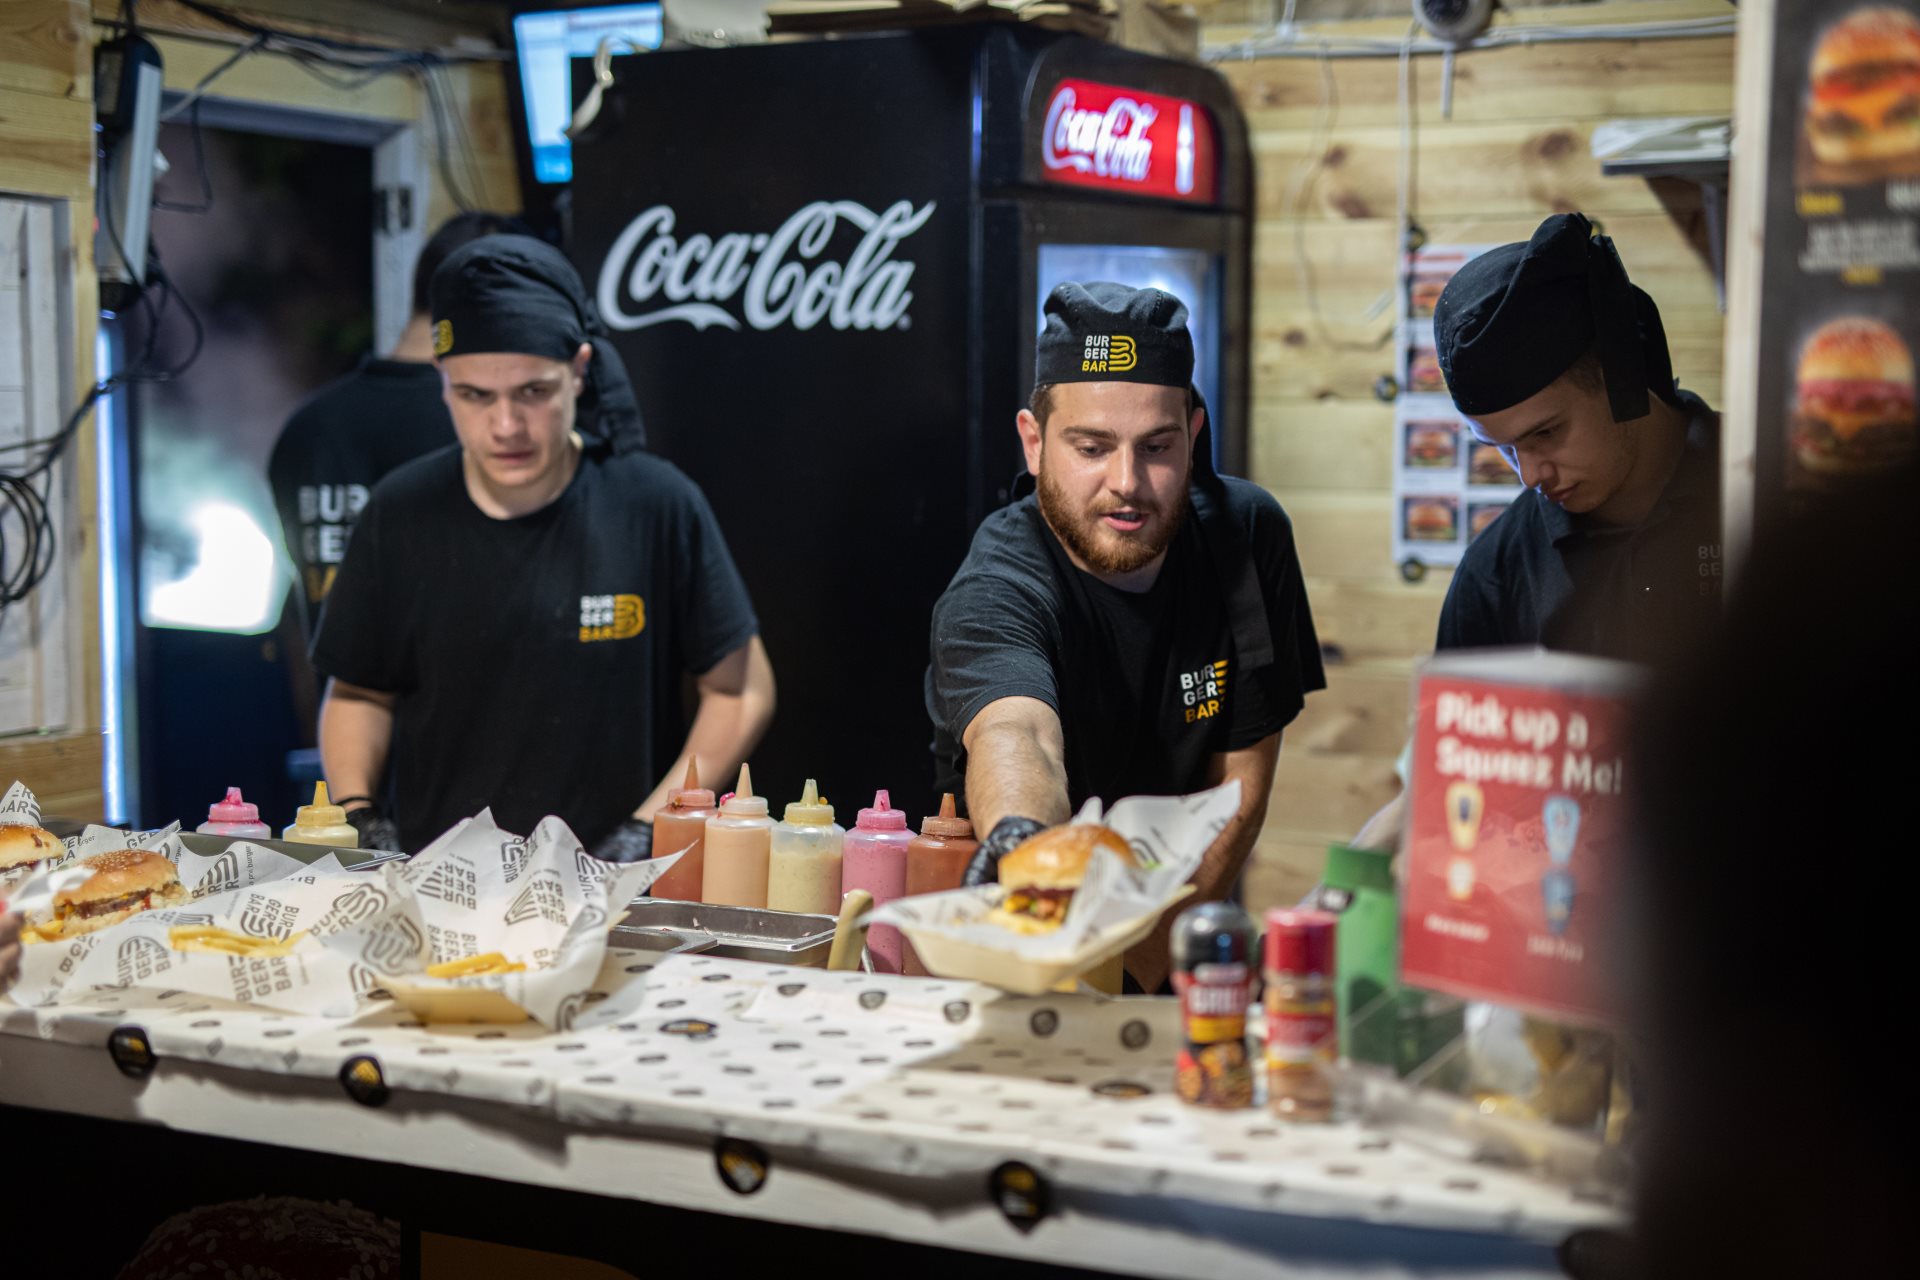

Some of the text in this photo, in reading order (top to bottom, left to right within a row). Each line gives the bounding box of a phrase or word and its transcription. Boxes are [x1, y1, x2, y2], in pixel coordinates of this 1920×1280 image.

[597, 200, 937, 331] Coca-Cola
[1085, 335, 1110, 347] BUR
[1084, 348, 1109, 360] GER
[1082, 360, 1107, 372] BAR
[1698, 545, 1721, 560] BU
[1699, 562, 1721, 577] GE
[581, 595, 614, 610] BUR
[580, 626, 613, 642] BAR
[1180, 664, 1216, 690] BUR
[1183, 681, 1219, 706] GER
[1185, 700, 1220, 723] BAR
[1435, 691, 1589, 753] Pick up a
[443, 861, 476, 883] BAR
[502, 862, 519, 883] BUR
[443, 877, 476, 896] GER
[532, 879, 564, 898] BAR
[264, 898, 282, 921] GER
[443, 890, 477, 910] BUR
[281, 905, 300, 929] BUR
[231, 966, 253, 1002] BUR
[250, 959, 272, 997] GER
[270, 957, 293, 992] BAR
